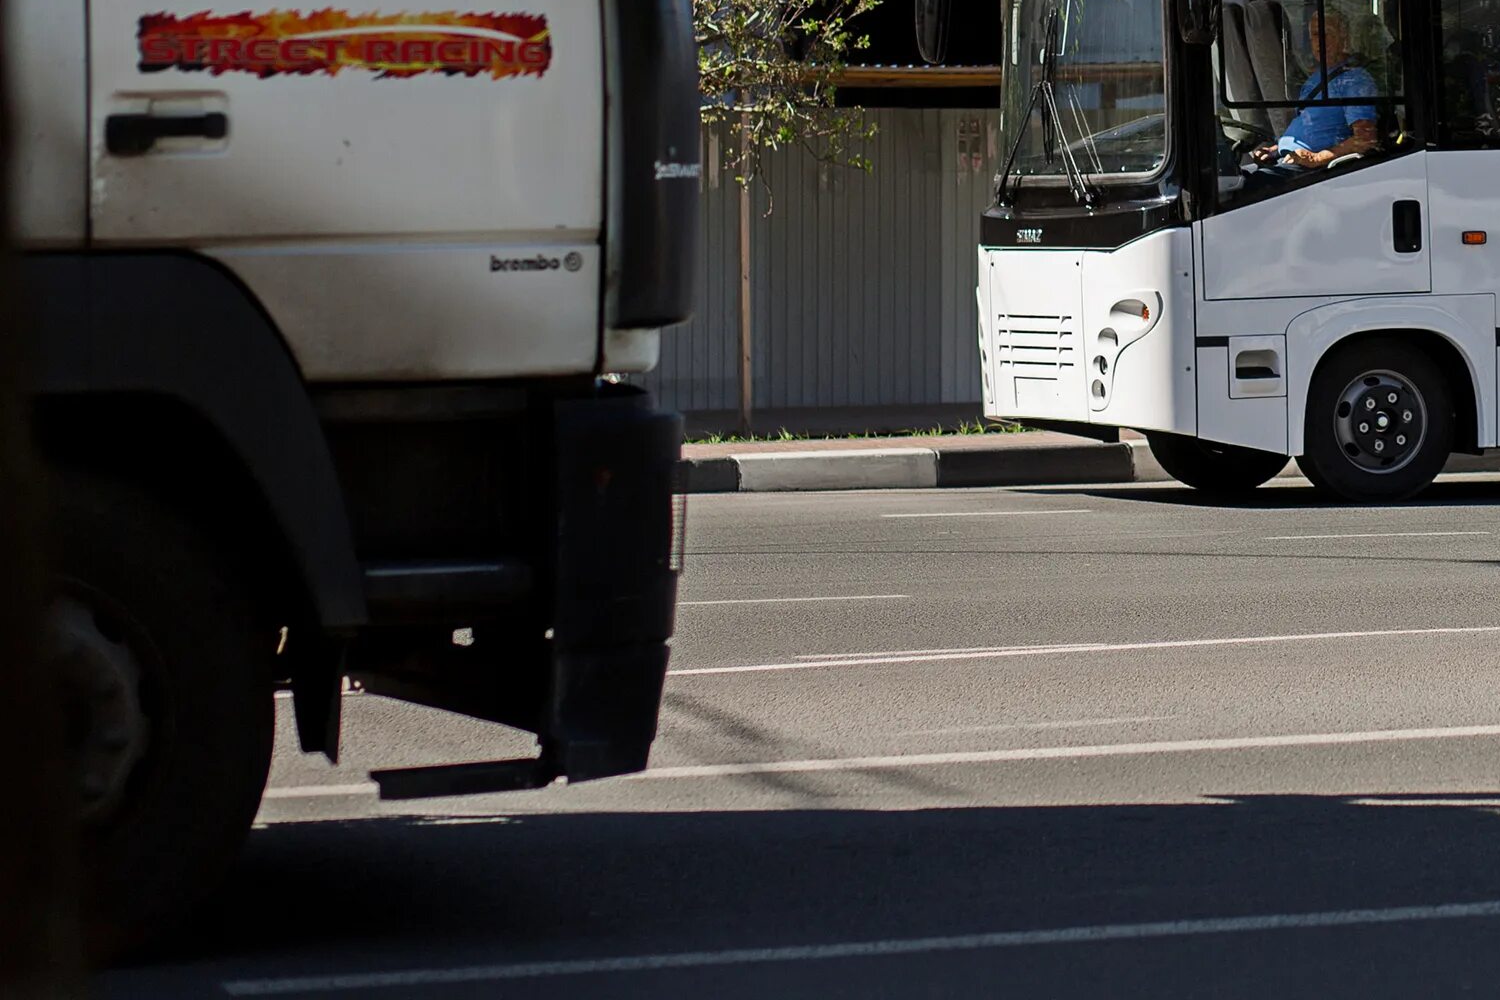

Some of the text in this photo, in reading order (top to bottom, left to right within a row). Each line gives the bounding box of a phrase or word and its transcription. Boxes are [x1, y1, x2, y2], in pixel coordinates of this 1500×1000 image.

[141, 34, 549, 65] STREET RACING
[490, 254, 560, 273] brembo
